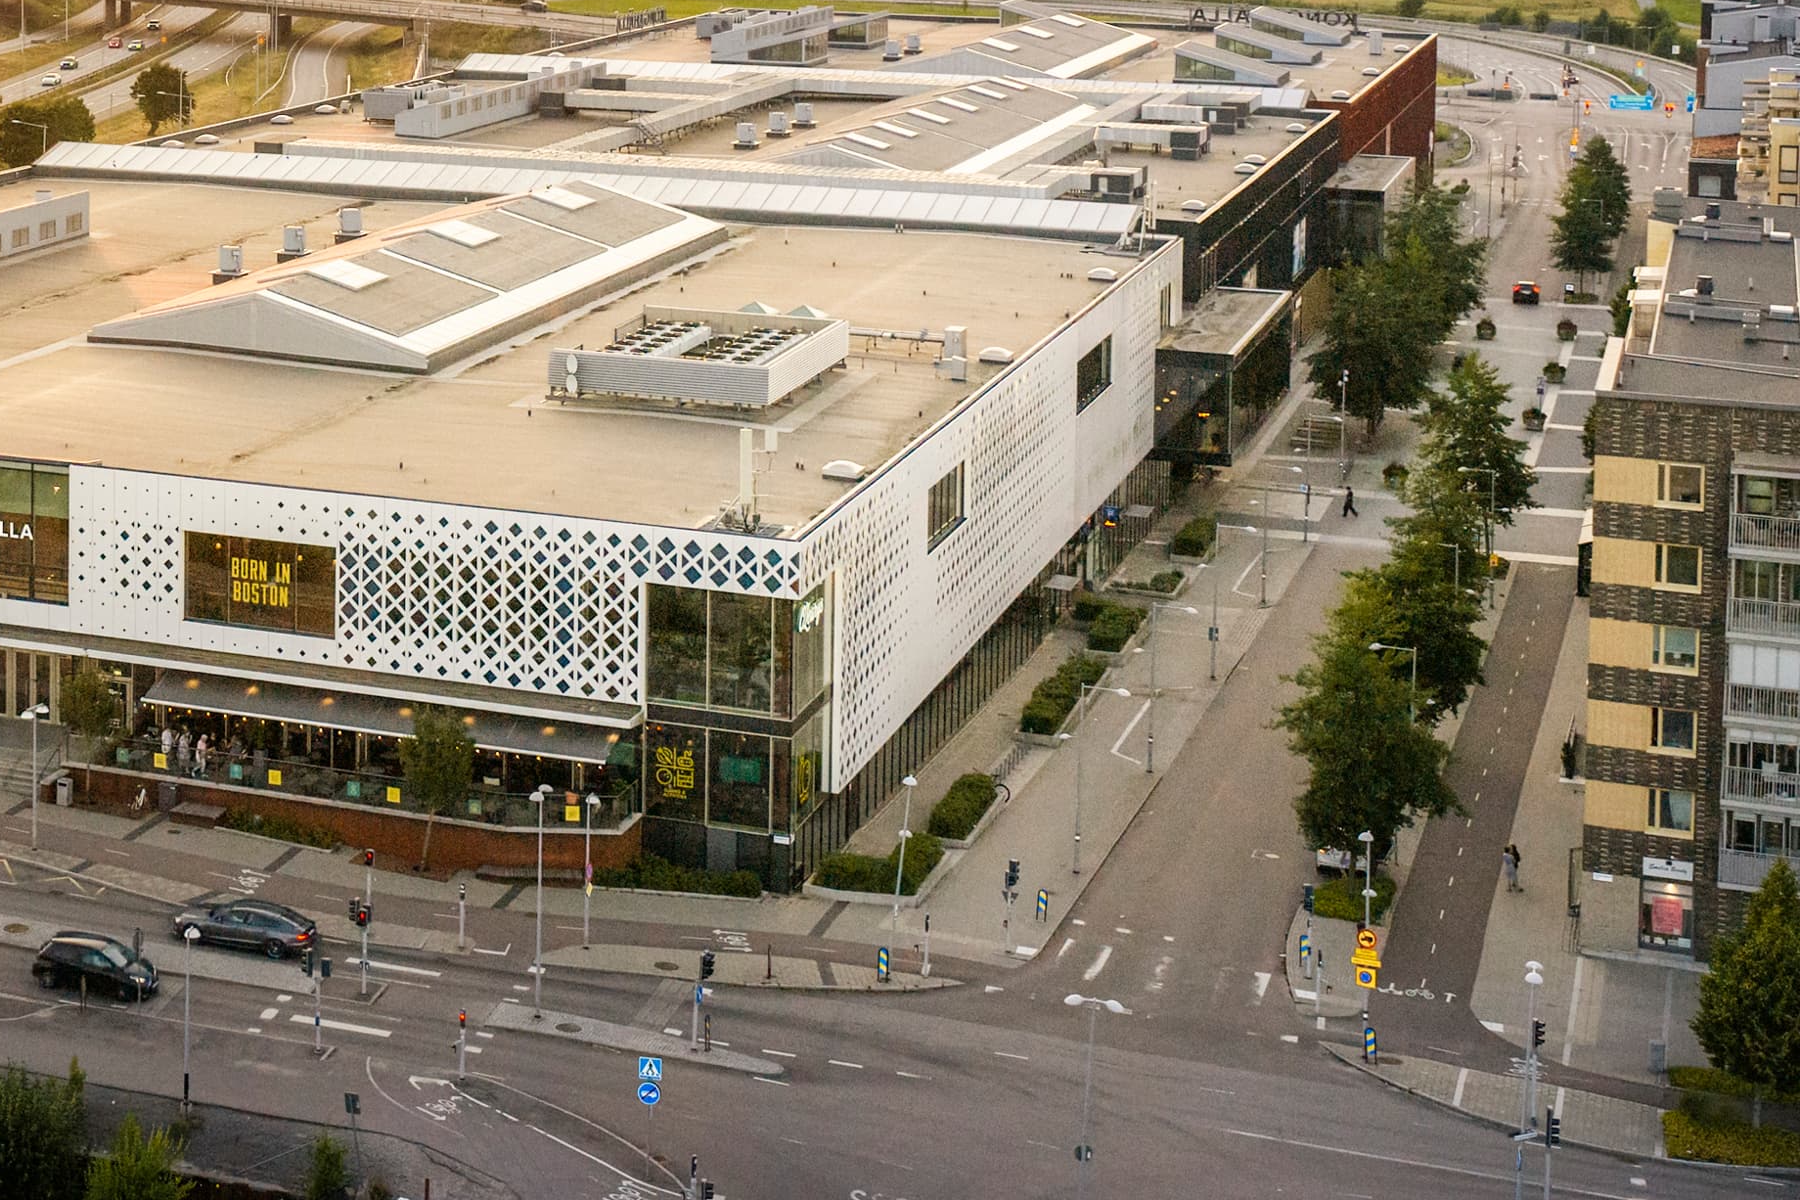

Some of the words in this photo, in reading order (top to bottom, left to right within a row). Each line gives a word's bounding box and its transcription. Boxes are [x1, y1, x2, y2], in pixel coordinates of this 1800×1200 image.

[231, 557, 267, 581] BORN
[275, 562, 291, 584] IN
[233, 581, 288, 608] BOSTON
